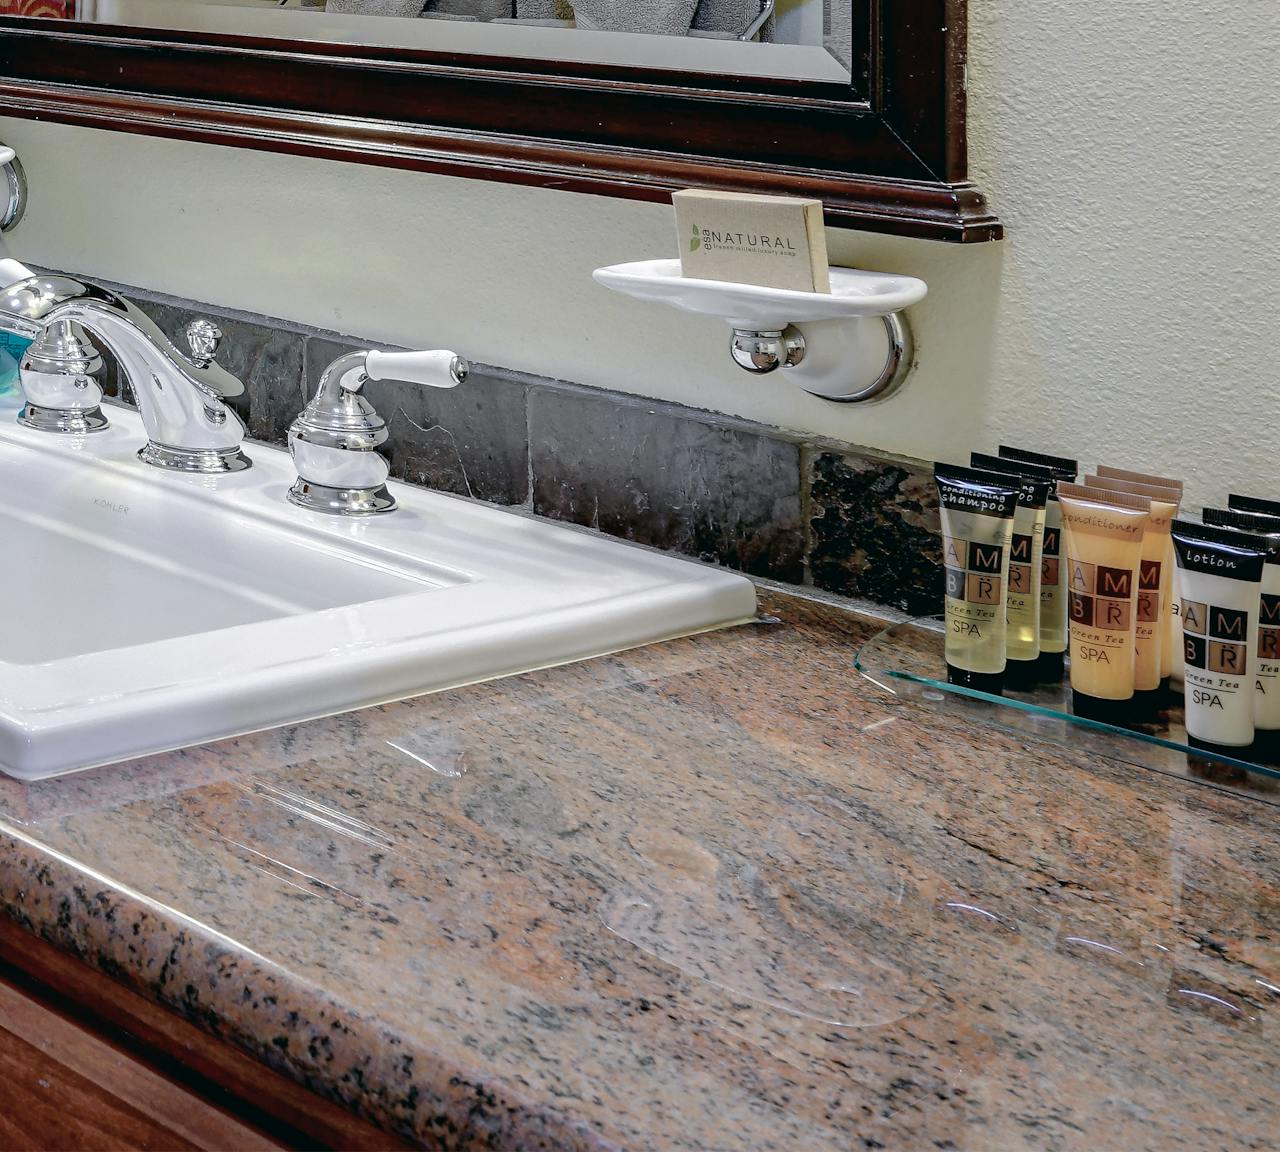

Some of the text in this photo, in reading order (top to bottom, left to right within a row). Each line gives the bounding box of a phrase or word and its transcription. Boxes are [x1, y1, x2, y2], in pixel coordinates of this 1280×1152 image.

[711, 231, 797, 250] NATURAL
[941, 492, 1006, 513] shampoo
[942, 485, 1006, 503] conditioning
[1062, 513, 1139, 534] conditioner
[976, 608, 996, 618] Tea
[953, 619, 982, 638] SPA
[1071, 627, 1125, 644] Green Tea
[1135, 626, 1153, 635] Tea
[1080, 646, 1111, 665] SPA
[1259, 663, 1280, 673] Tea
[1217, 678, 1240, 689] Tea
[1192, 689, 1225, 710] SPA
